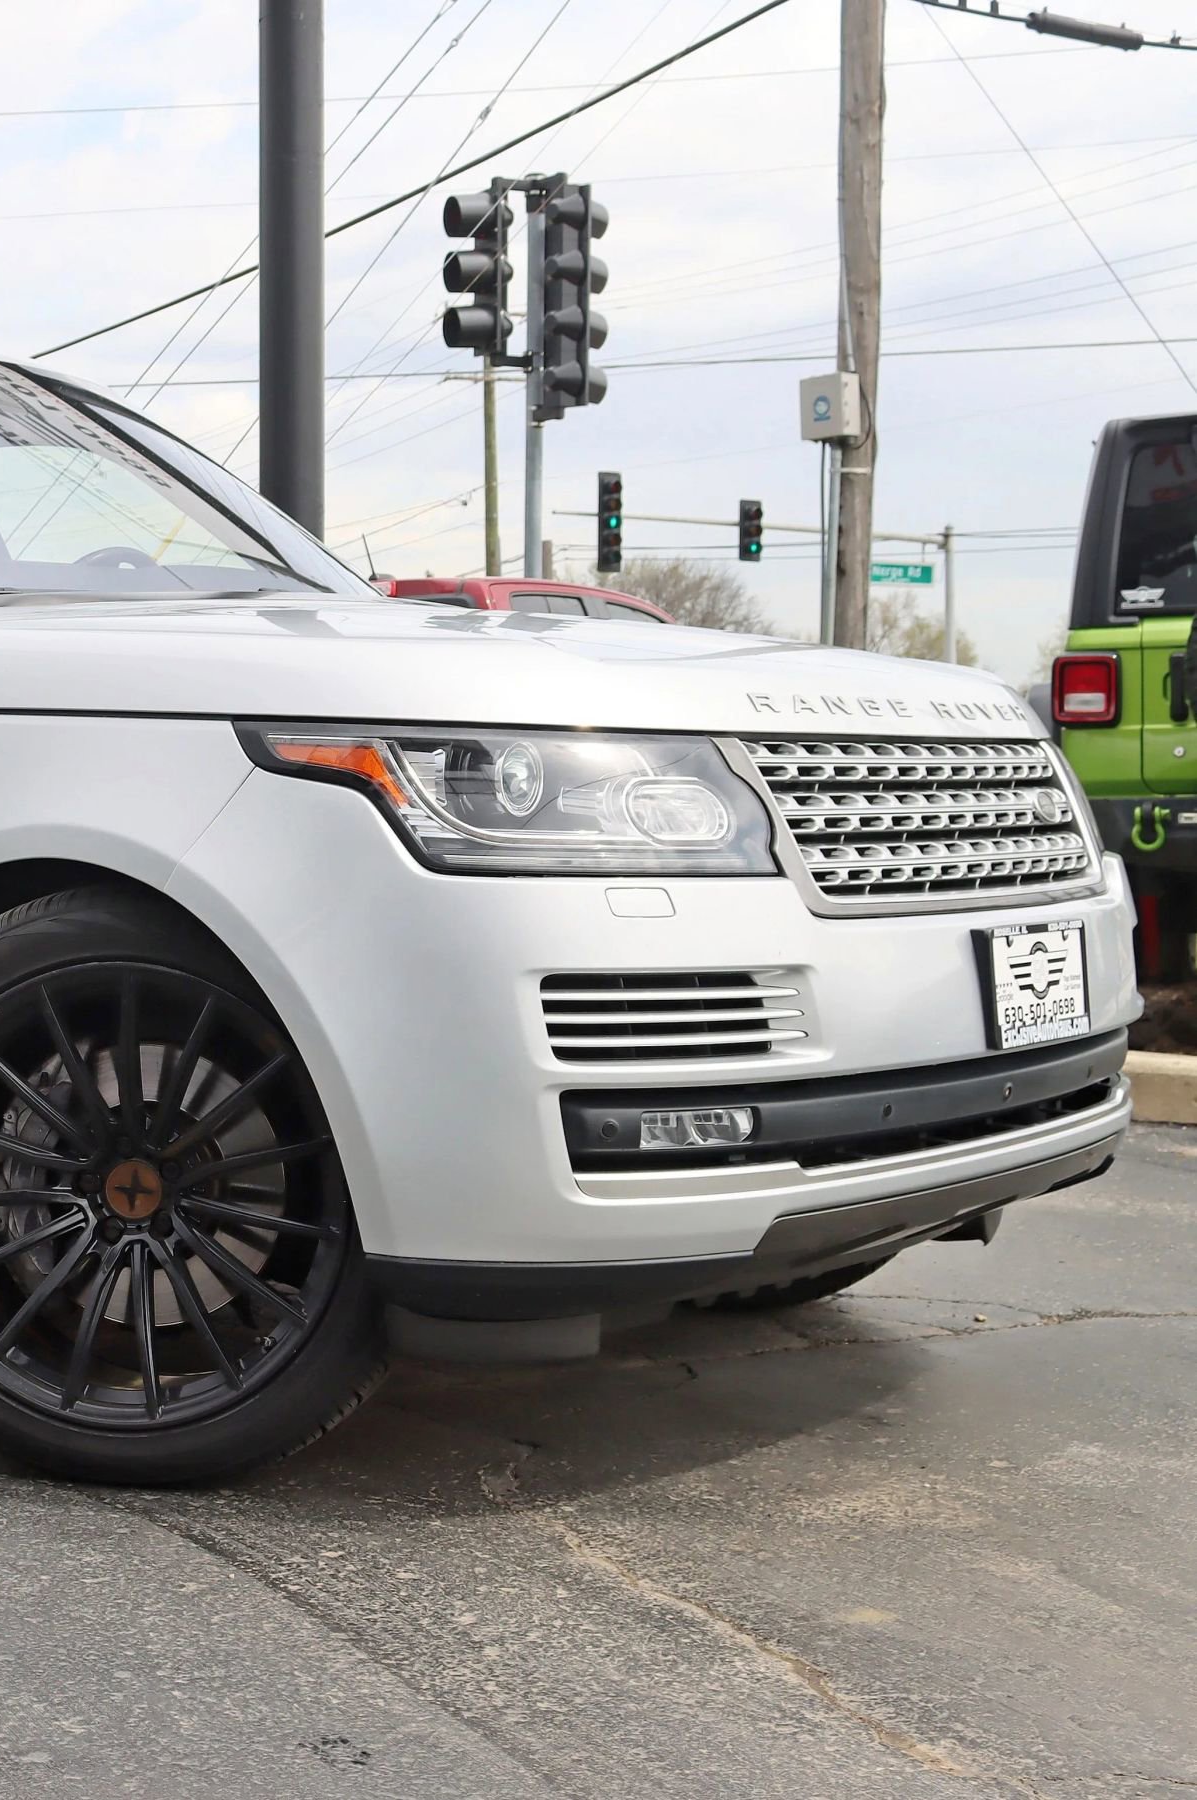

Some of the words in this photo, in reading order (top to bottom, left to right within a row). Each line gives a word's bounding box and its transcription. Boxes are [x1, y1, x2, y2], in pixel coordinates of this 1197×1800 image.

[907, 566, 922, 578] Rd
[746, 693, 914, 718] RANGE
[929, 700, 1027, 721] ROVER
[1004, 997, 1076, 1025] 630-501-0698
